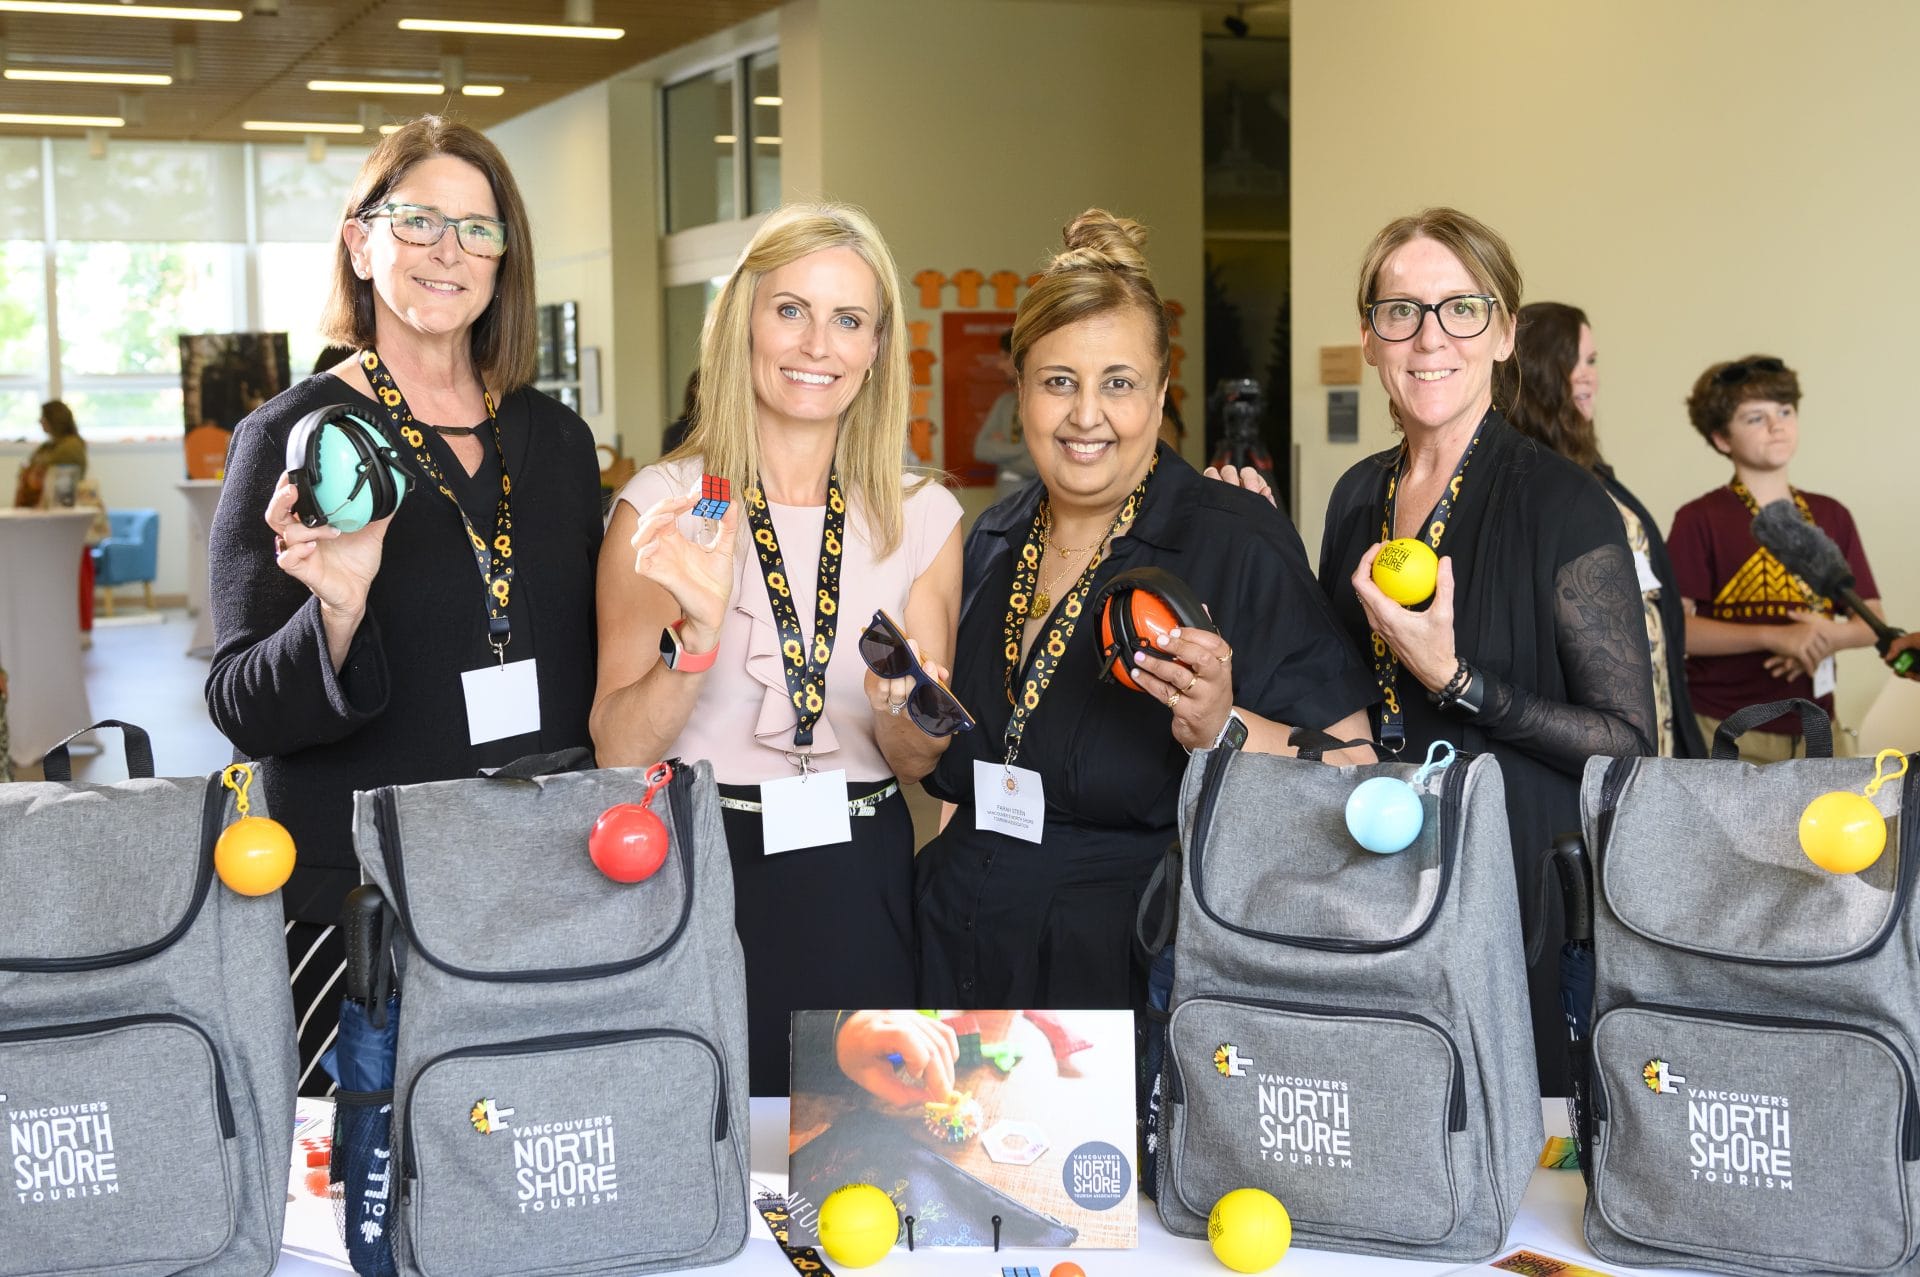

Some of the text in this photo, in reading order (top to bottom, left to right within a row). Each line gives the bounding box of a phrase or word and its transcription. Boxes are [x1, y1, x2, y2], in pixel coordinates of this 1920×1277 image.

[1378, 553, 1403, 571] SHORE
[1258, 1073, 1349, 1091] VANCOUVER'S
[1258, 1084, 1349, 1130] NORTH
[1688, 1088, 1789, 1107] VANCOUVER'S
[9, 1101, 108, 1120] VANCOUVER'S
[513, 1115, 613, 1138] VANCOUVER'S
[1259, 1114, 1351, 1156] SHORE
[1688, 1100, 1790, 1148] NORTH
[10, 1113, 114, 1159] NORTH
[513, 1126, 616, 1173] NORTH
[1260, 1150, 1352, 1169] TOURISM
[1690, 1132, 1792, 1177] SHORE
[14, 1146, 117, 1190] SHORE
[1073, 1160, 1121, 1180] NORTH
[516, 1160, 617, 1200] SHORE
[1073, 1174, 1121, 1193] SHORE
[1691, 1169, 1793, 1191] TOURISM
[17, 1183, 119, 1204] TOURISM
[518, 1190, 618, 1213] TOURISM
